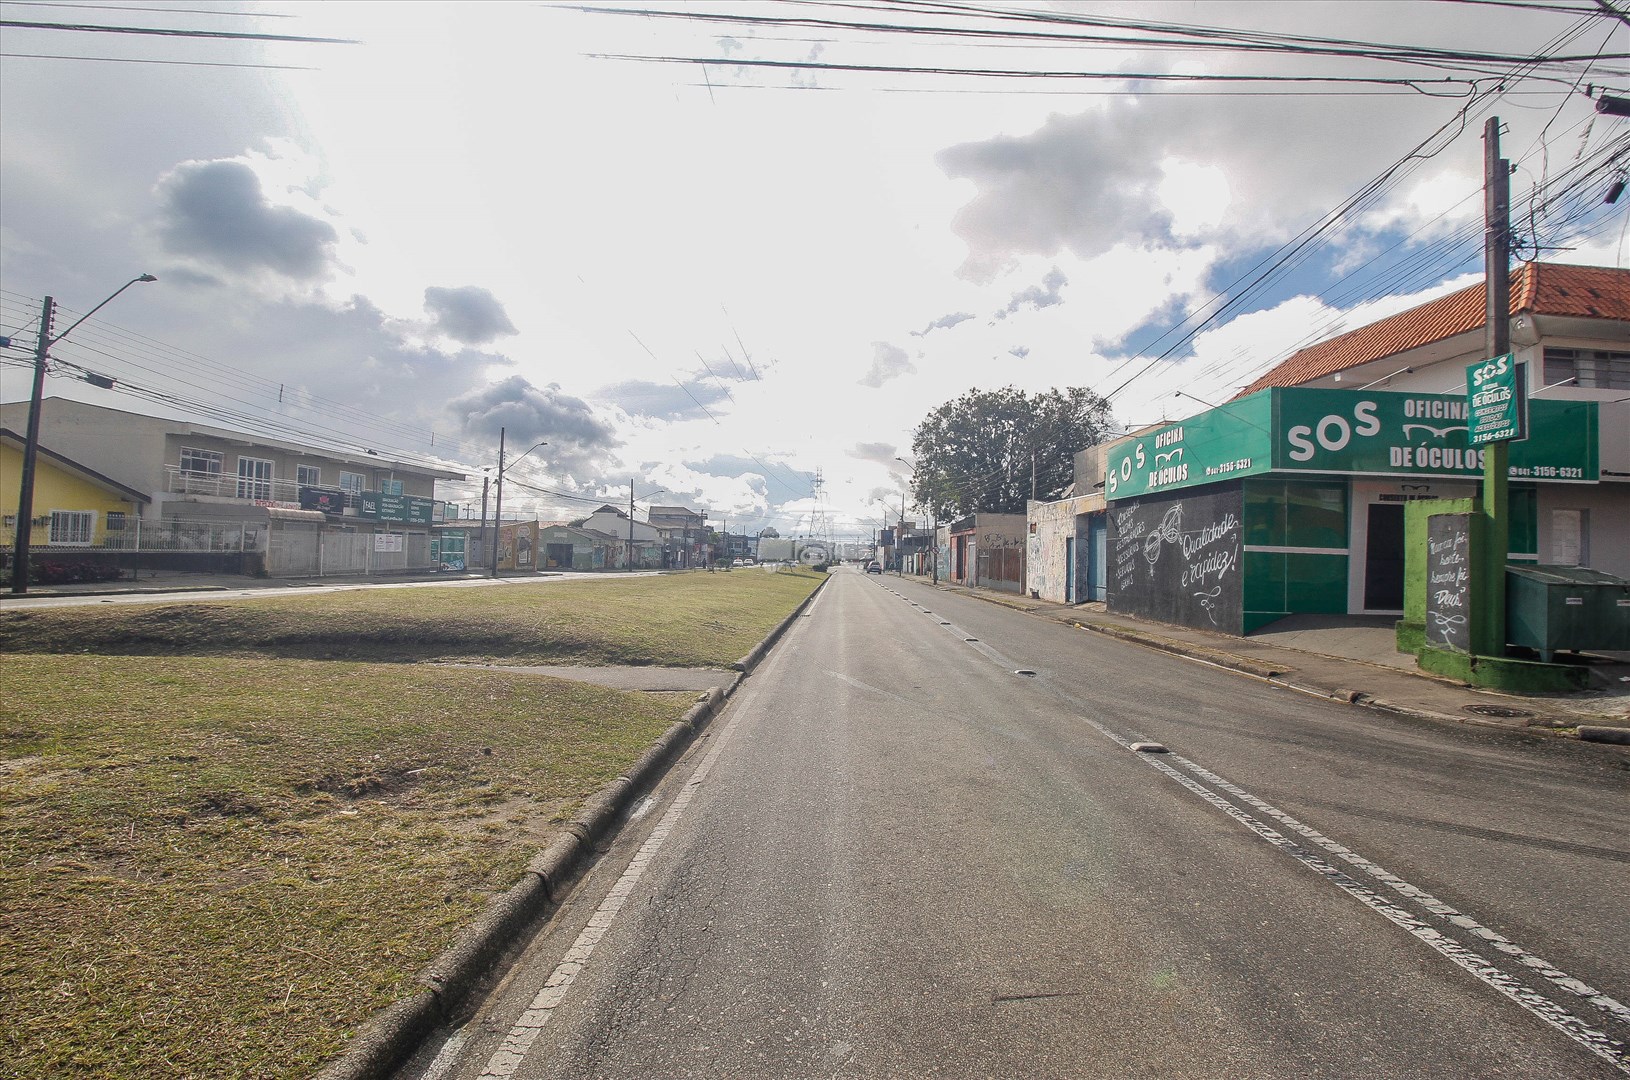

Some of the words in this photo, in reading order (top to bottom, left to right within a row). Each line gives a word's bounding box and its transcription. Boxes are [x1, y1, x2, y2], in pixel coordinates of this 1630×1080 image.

[1473, 356, 1508, 387] SOS
[1472, 395, 1482, 408] DE
[1155, 426, 1184, 449] OFICINA
[1287, 400, 1381, 462] SOS
[1472, 428, 1515, 443] 3156-6321
[1389, 446, 1413, 467] DE
[1148, 470, 1158, 487] DE
[1158, 463, 1189, 486] ÓCULOS
[1183, 513, 1238, 560] Qualidade
[1181, 571, 1189, 587] e
